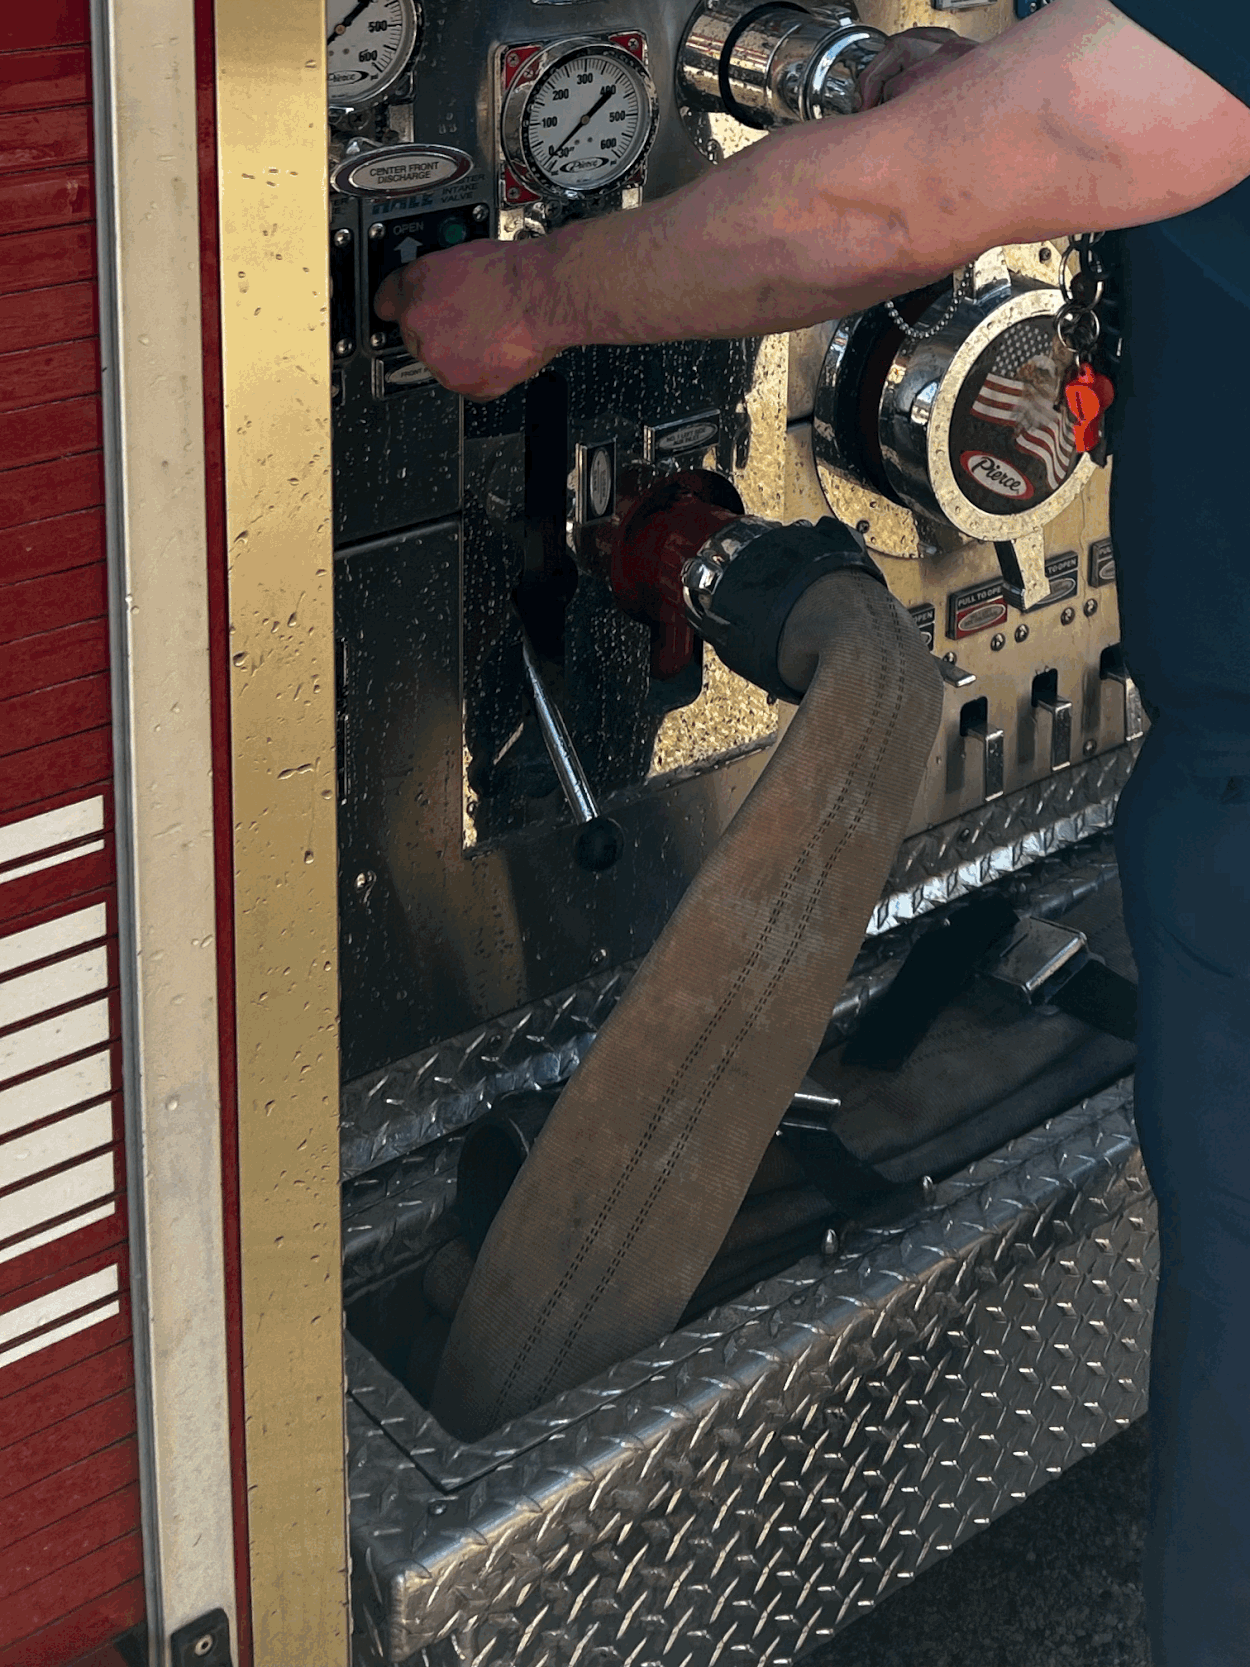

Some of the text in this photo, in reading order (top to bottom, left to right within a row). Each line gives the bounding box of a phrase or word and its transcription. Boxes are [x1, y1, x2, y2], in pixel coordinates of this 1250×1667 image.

[368, 20, 388, 32] 500
[358, 50, 378, 63] 600
[577, 73, 593, 85] 300
[552, 88, 569, 101] 200
[542, 110, 626, 128] 100 500
[600, 138, 617, 150] 600
[370, 162, 439, 177] CENTER FRONT
[569, 160, 598, 171] Pierce
[378, 171, 431, 184] DISCHARGE
[442, 184, 478, 194] INTAKE
[441, 192, 474, 203] VALVE
[393, 221, 424, 235] OPEN
[972, 456, 1021, 492] Pierce
[1048, 558, 1077, 574] TO OPEN
[957, 587, 1001, 608] PULL TO OPE
